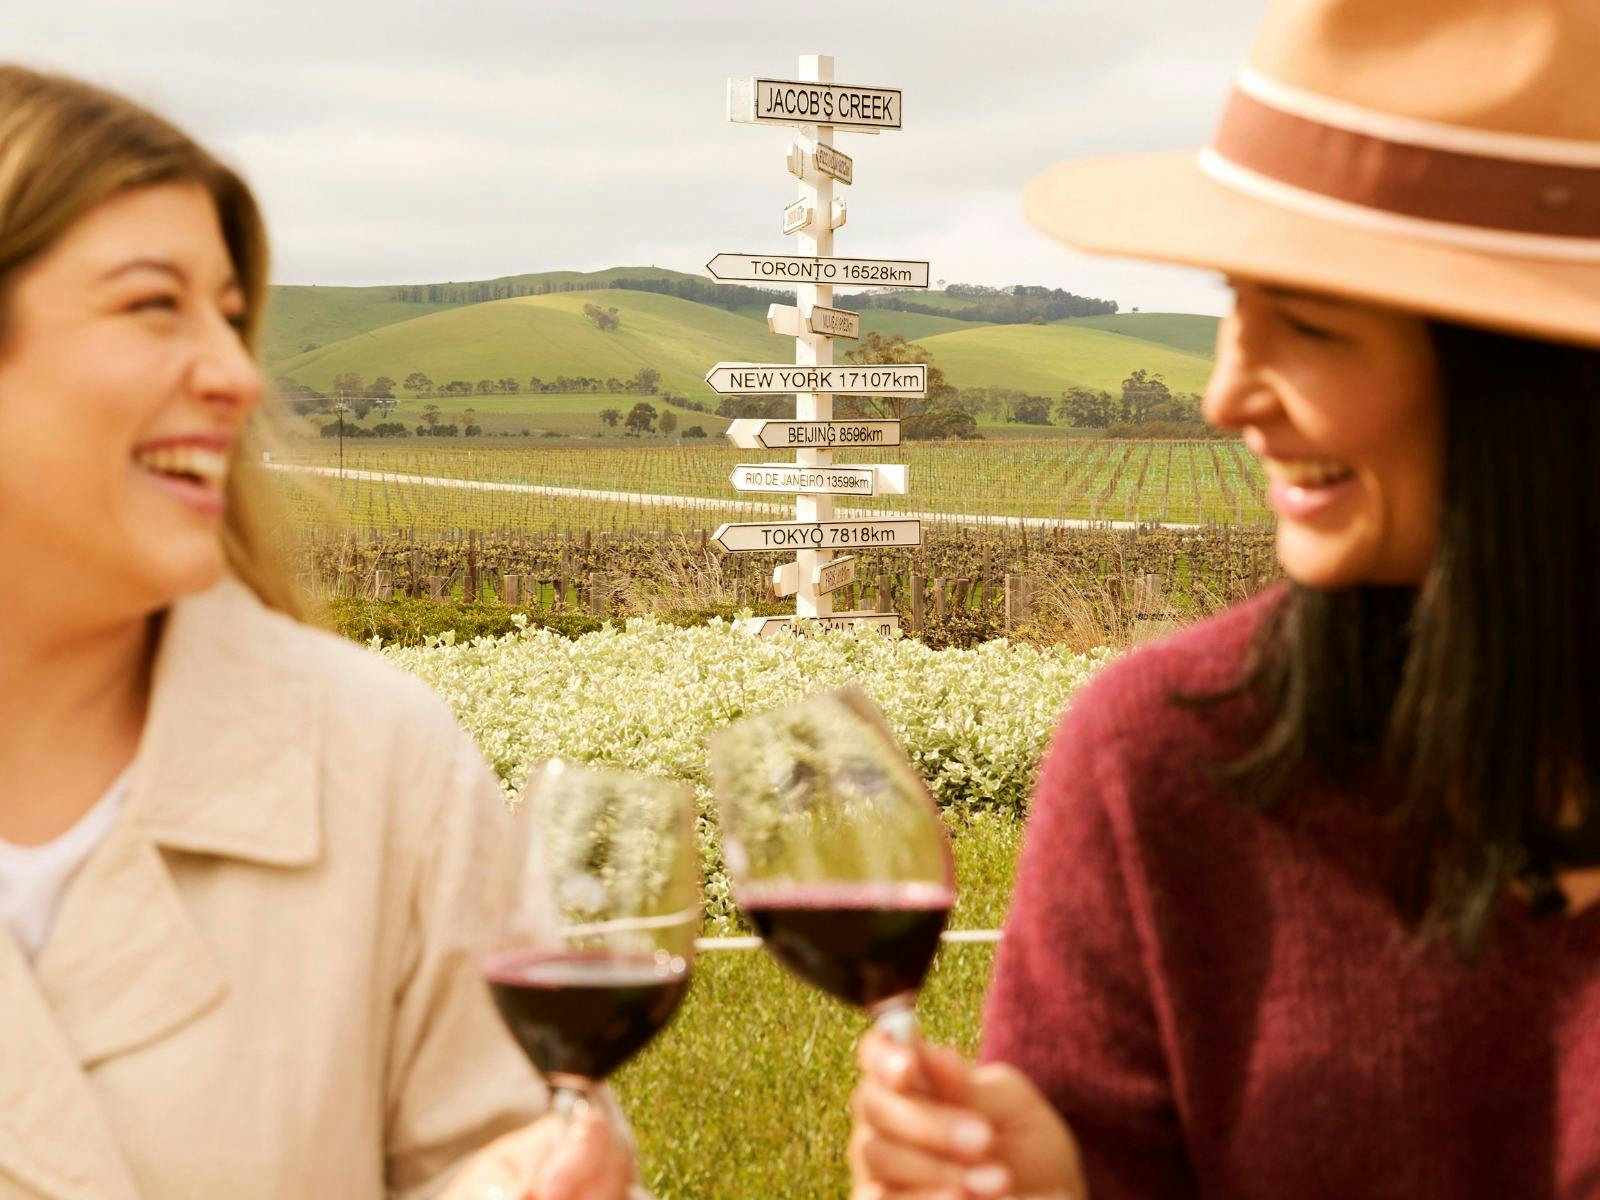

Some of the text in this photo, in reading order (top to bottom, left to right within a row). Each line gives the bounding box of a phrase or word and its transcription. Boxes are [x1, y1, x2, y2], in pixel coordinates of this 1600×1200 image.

[766, 88, 893, 121] JACOB'S CREEK
[751, 261, 912, 281] TORONTO 16528km
[730, 372, 919, 388] NEW YORK 17107km
[788, 426, 883, 443] BEIJING 8596km
[745, 473, 869, 489] RIO DE JANEIRO 13599km
[761, 527, 895, 545] TOKYO 7818km
